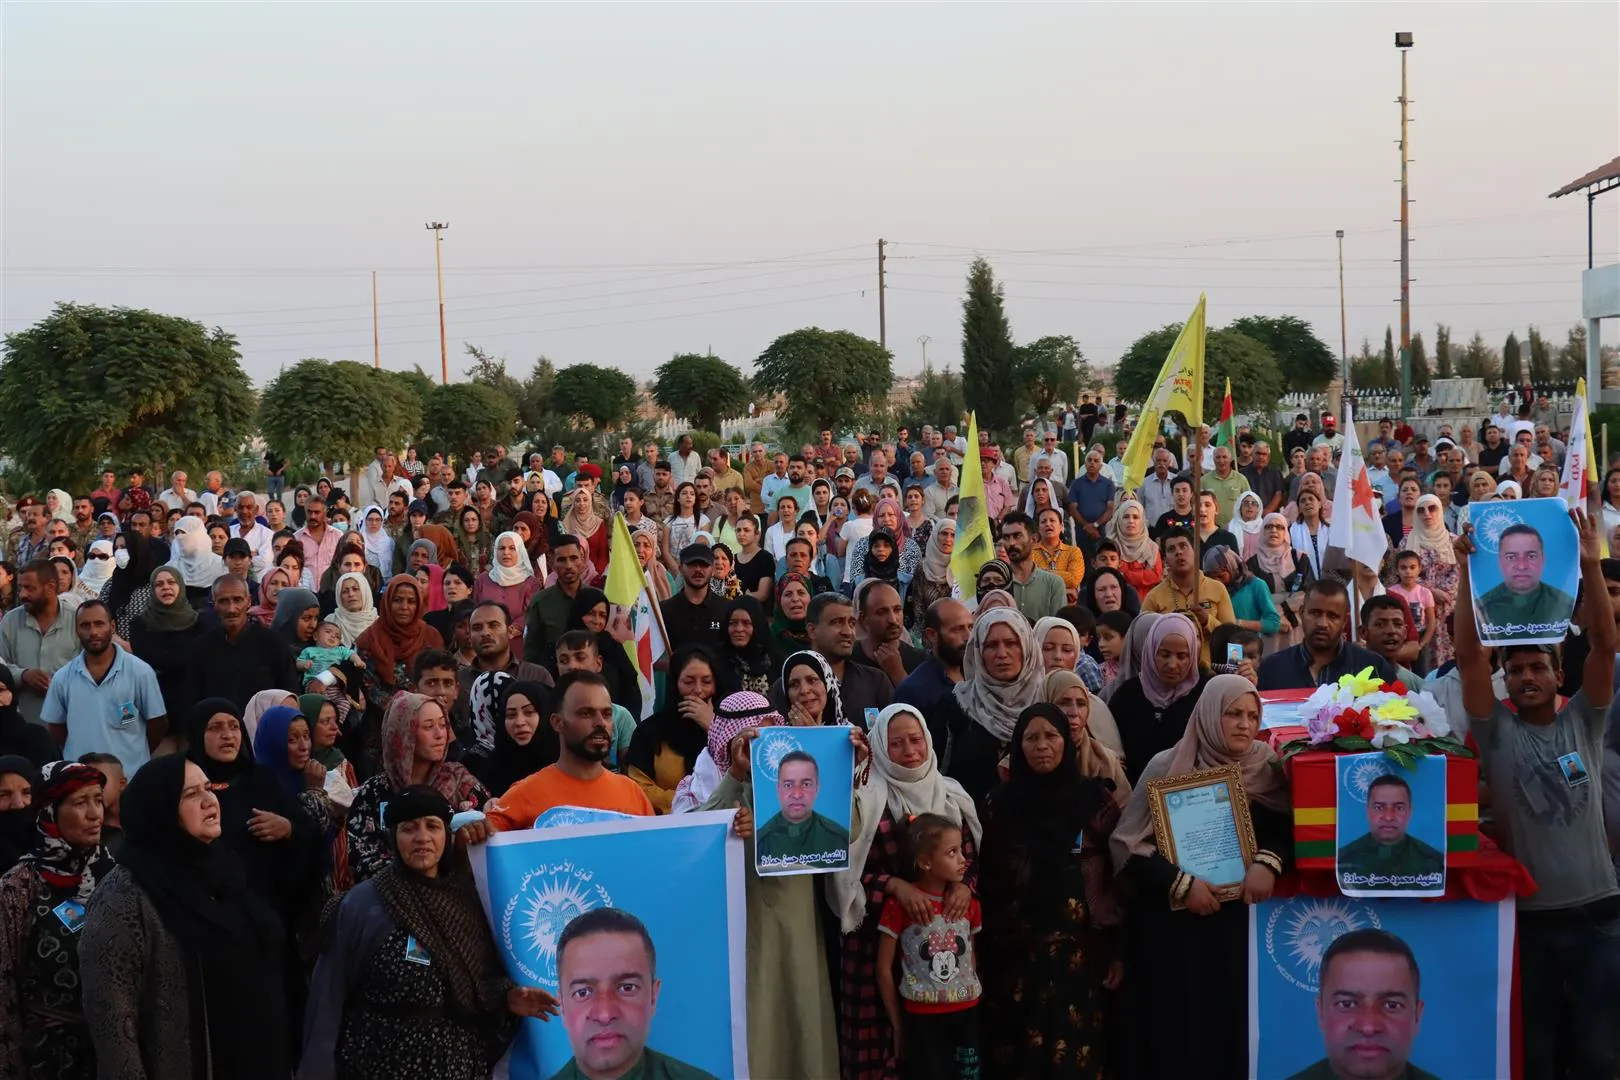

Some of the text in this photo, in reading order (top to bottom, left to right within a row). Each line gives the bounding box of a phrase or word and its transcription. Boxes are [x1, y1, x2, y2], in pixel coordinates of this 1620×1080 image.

[1571, 454, 1580, 481] PYD
[1505, 622, 1526, 635] حسن
[1527, 623, 1551, 634] محمود
[781, 854, 798, 867] حسن
[799, 853, 820, 865] محمود
[821, 849, 846, 863] الشهيد
[549, 858, 575, 876] الأمن
[1368, 872, 1390, 887] حسن
[1390, 875, 1415, 887] محمود
[1416, 872, 1442, 887] الشهيد
